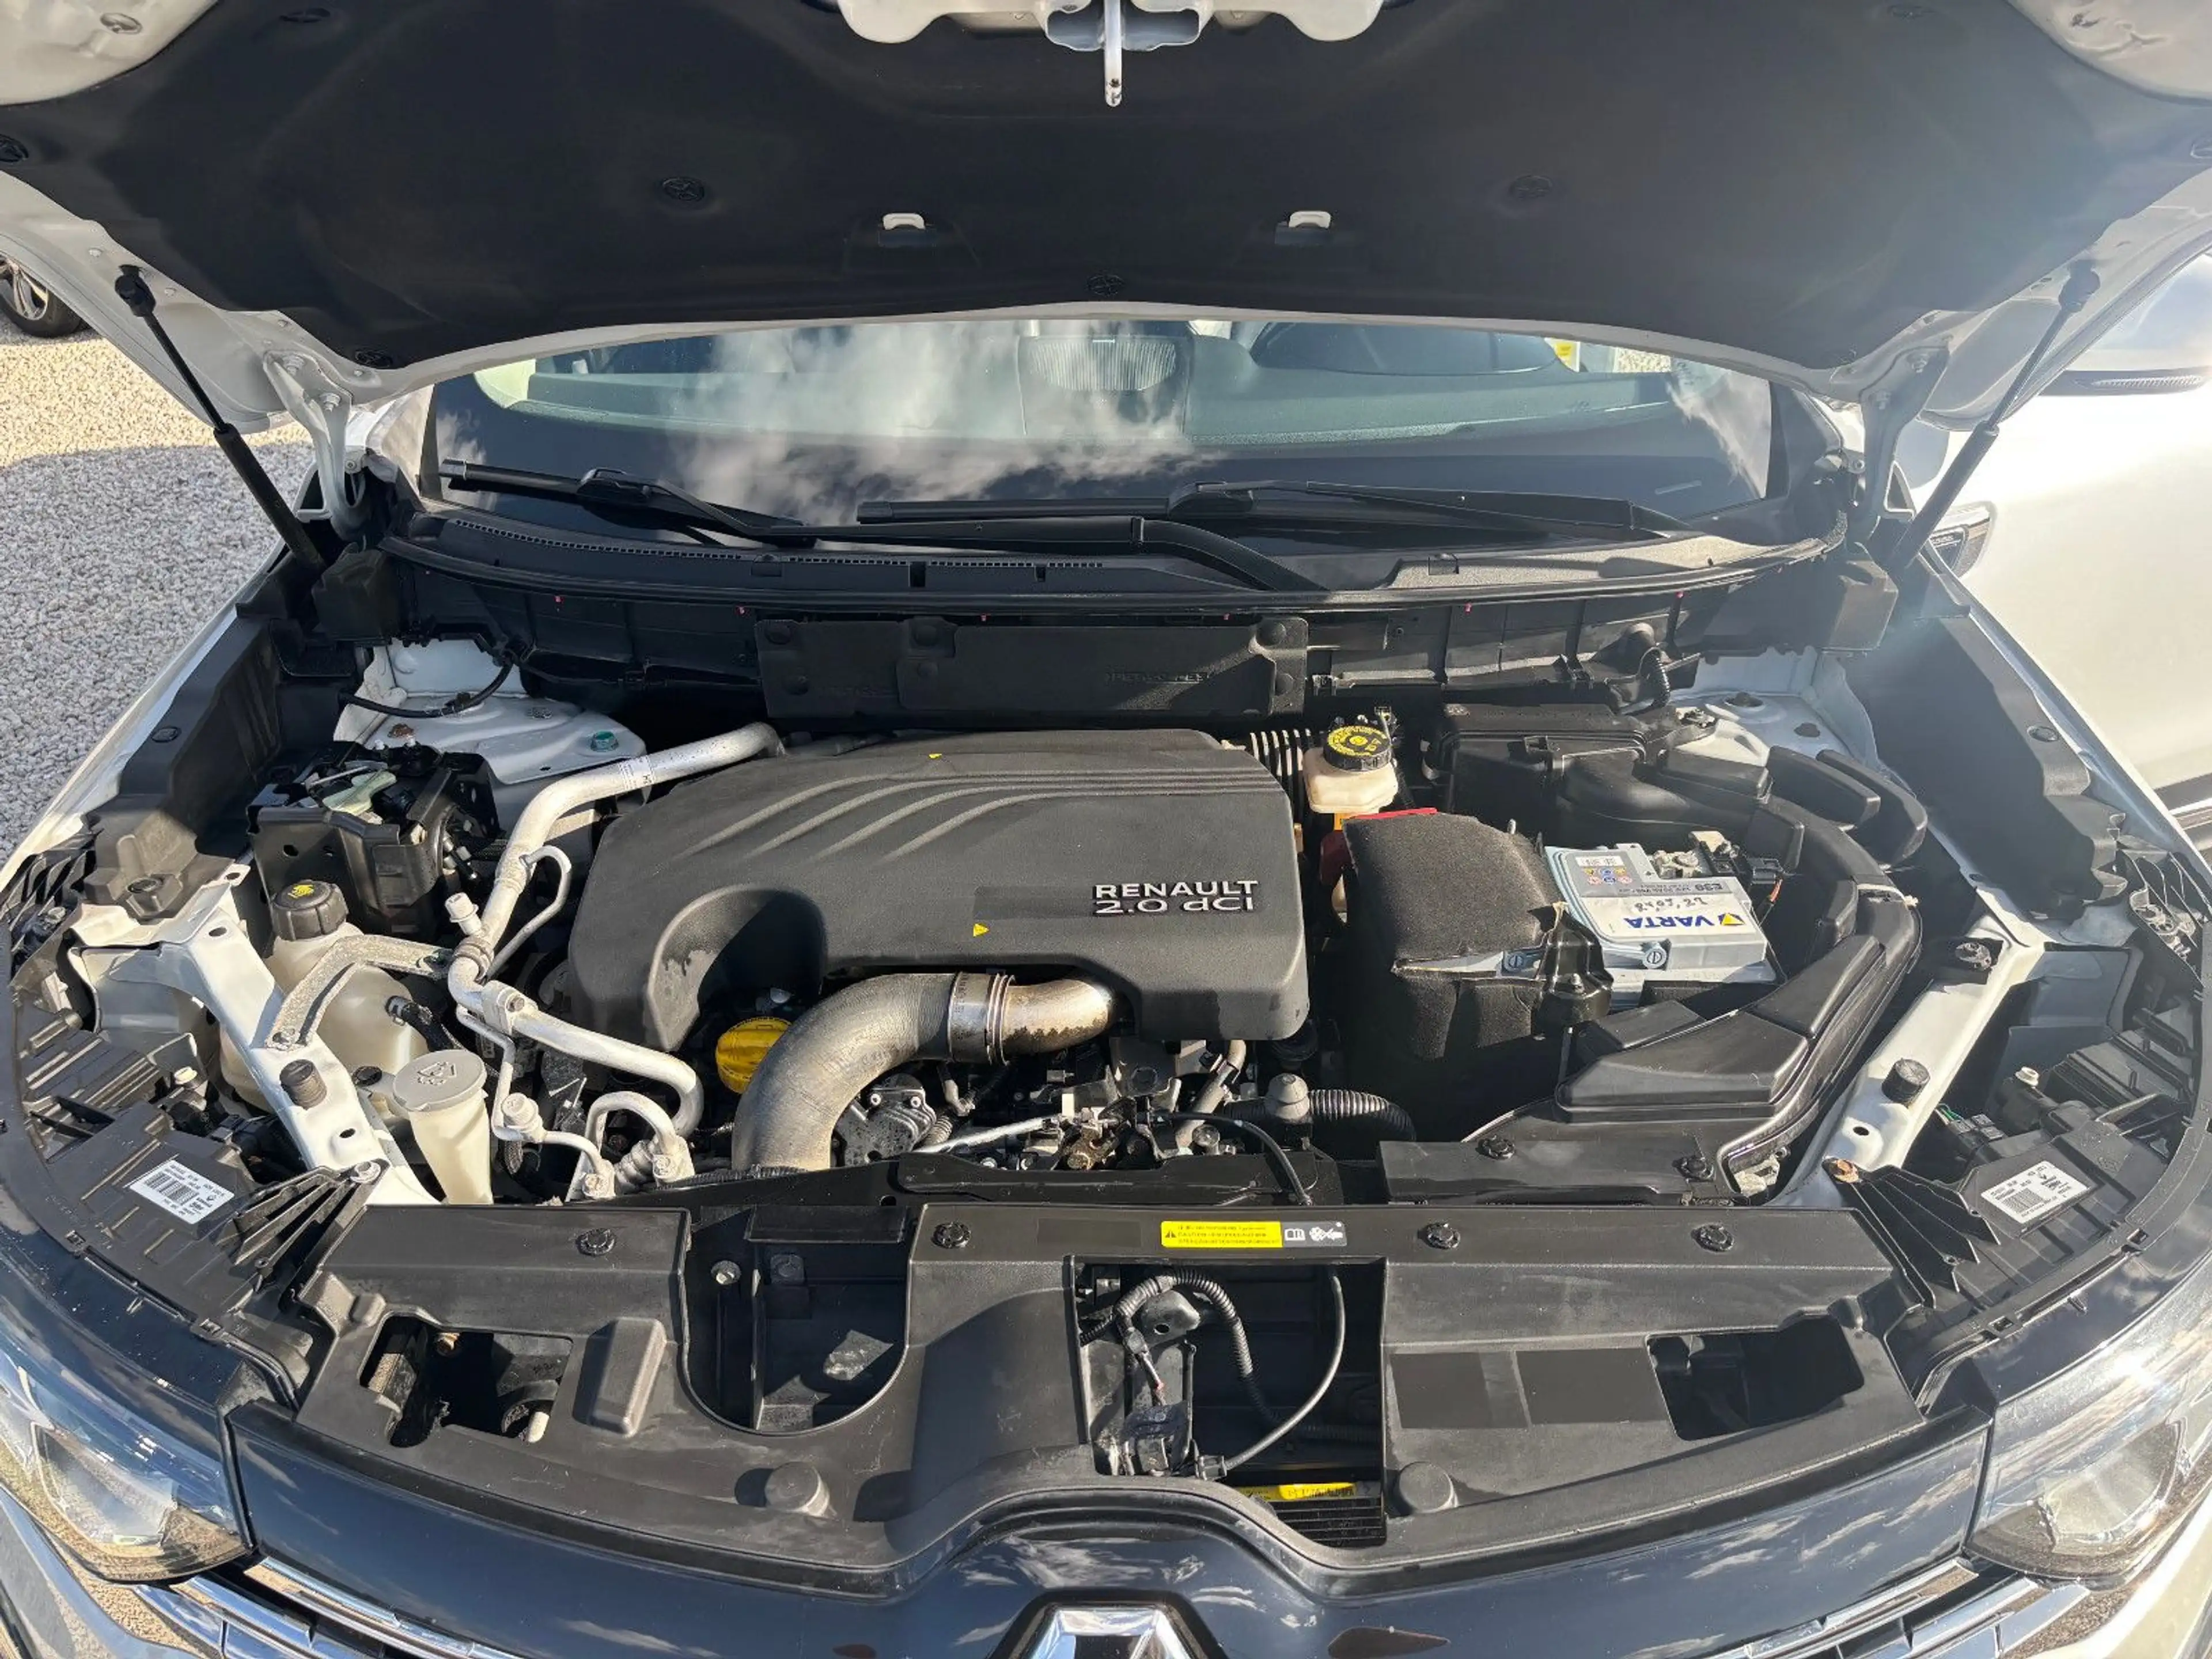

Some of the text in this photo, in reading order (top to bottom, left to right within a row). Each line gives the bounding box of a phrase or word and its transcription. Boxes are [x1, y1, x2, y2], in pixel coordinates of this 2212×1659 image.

[1094, 880, 1258, 898] RENAULT
[1094, 899, 1168, 914] 2.0
[1623, 915, 1714, 928] VARTA
